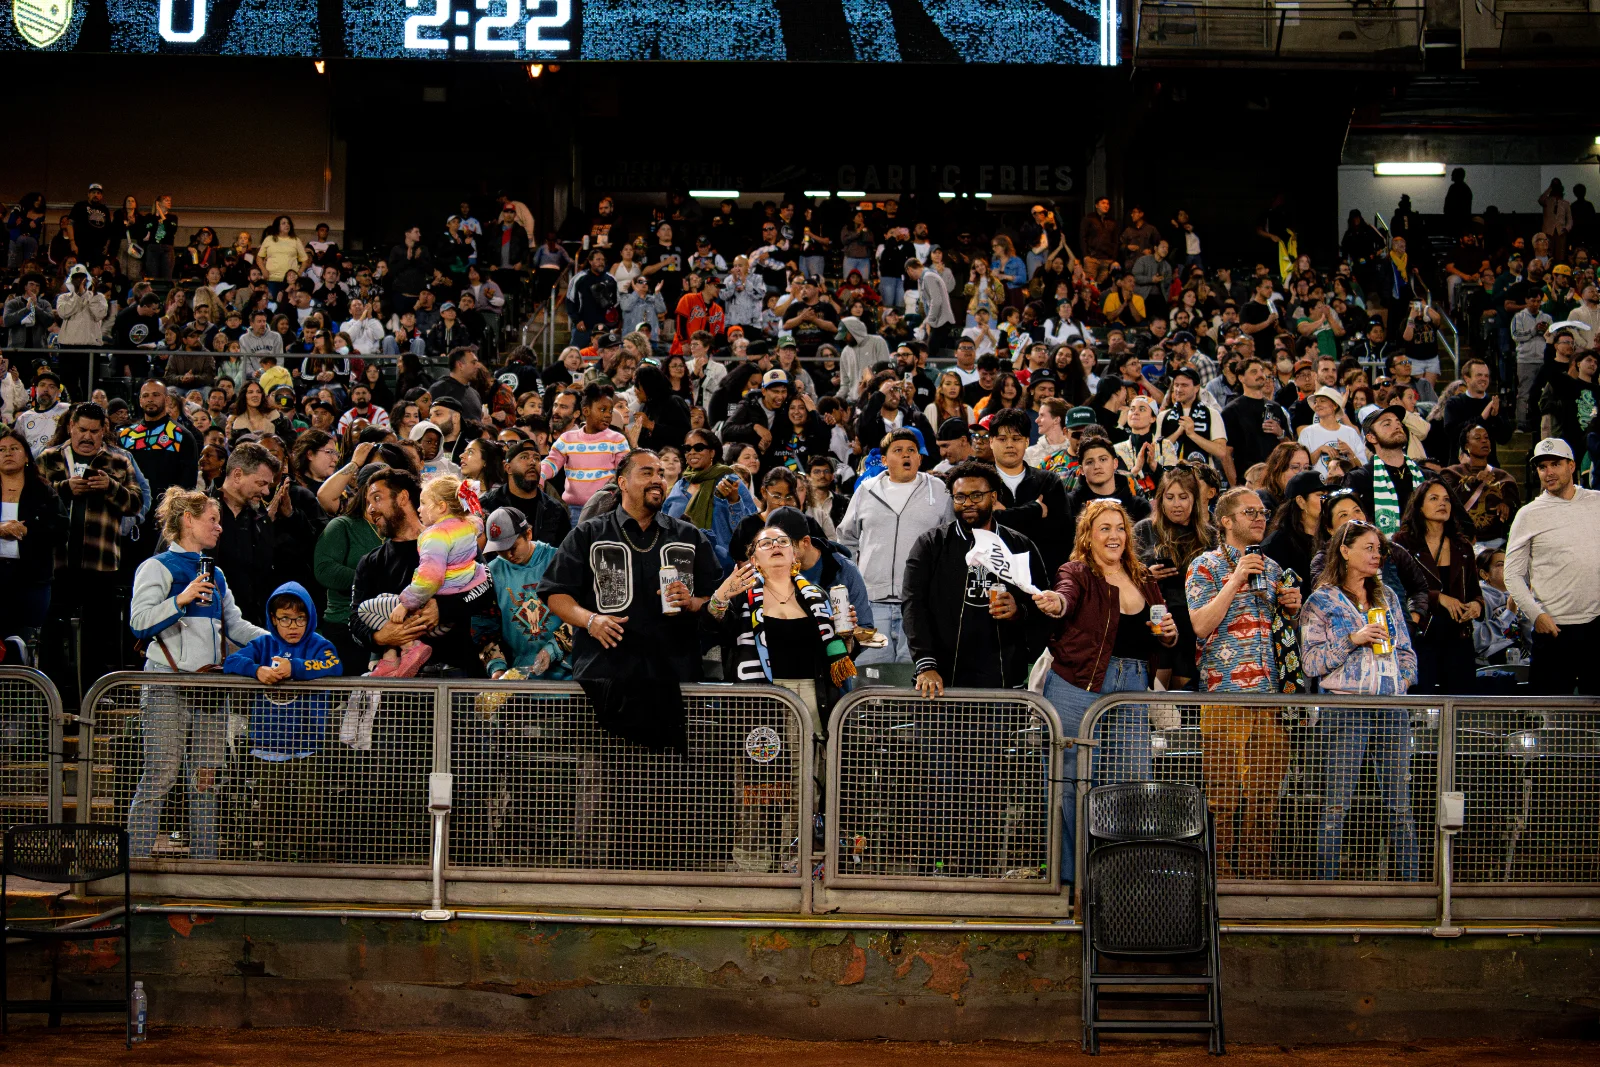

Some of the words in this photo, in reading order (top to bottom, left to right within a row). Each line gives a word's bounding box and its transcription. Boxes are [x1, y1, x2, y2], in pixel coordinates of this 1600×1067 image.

[404, 0, 571, 50] 2:22
[979, 165, 1074, 191] FRIES
[971, 580, 991, 588] THE
